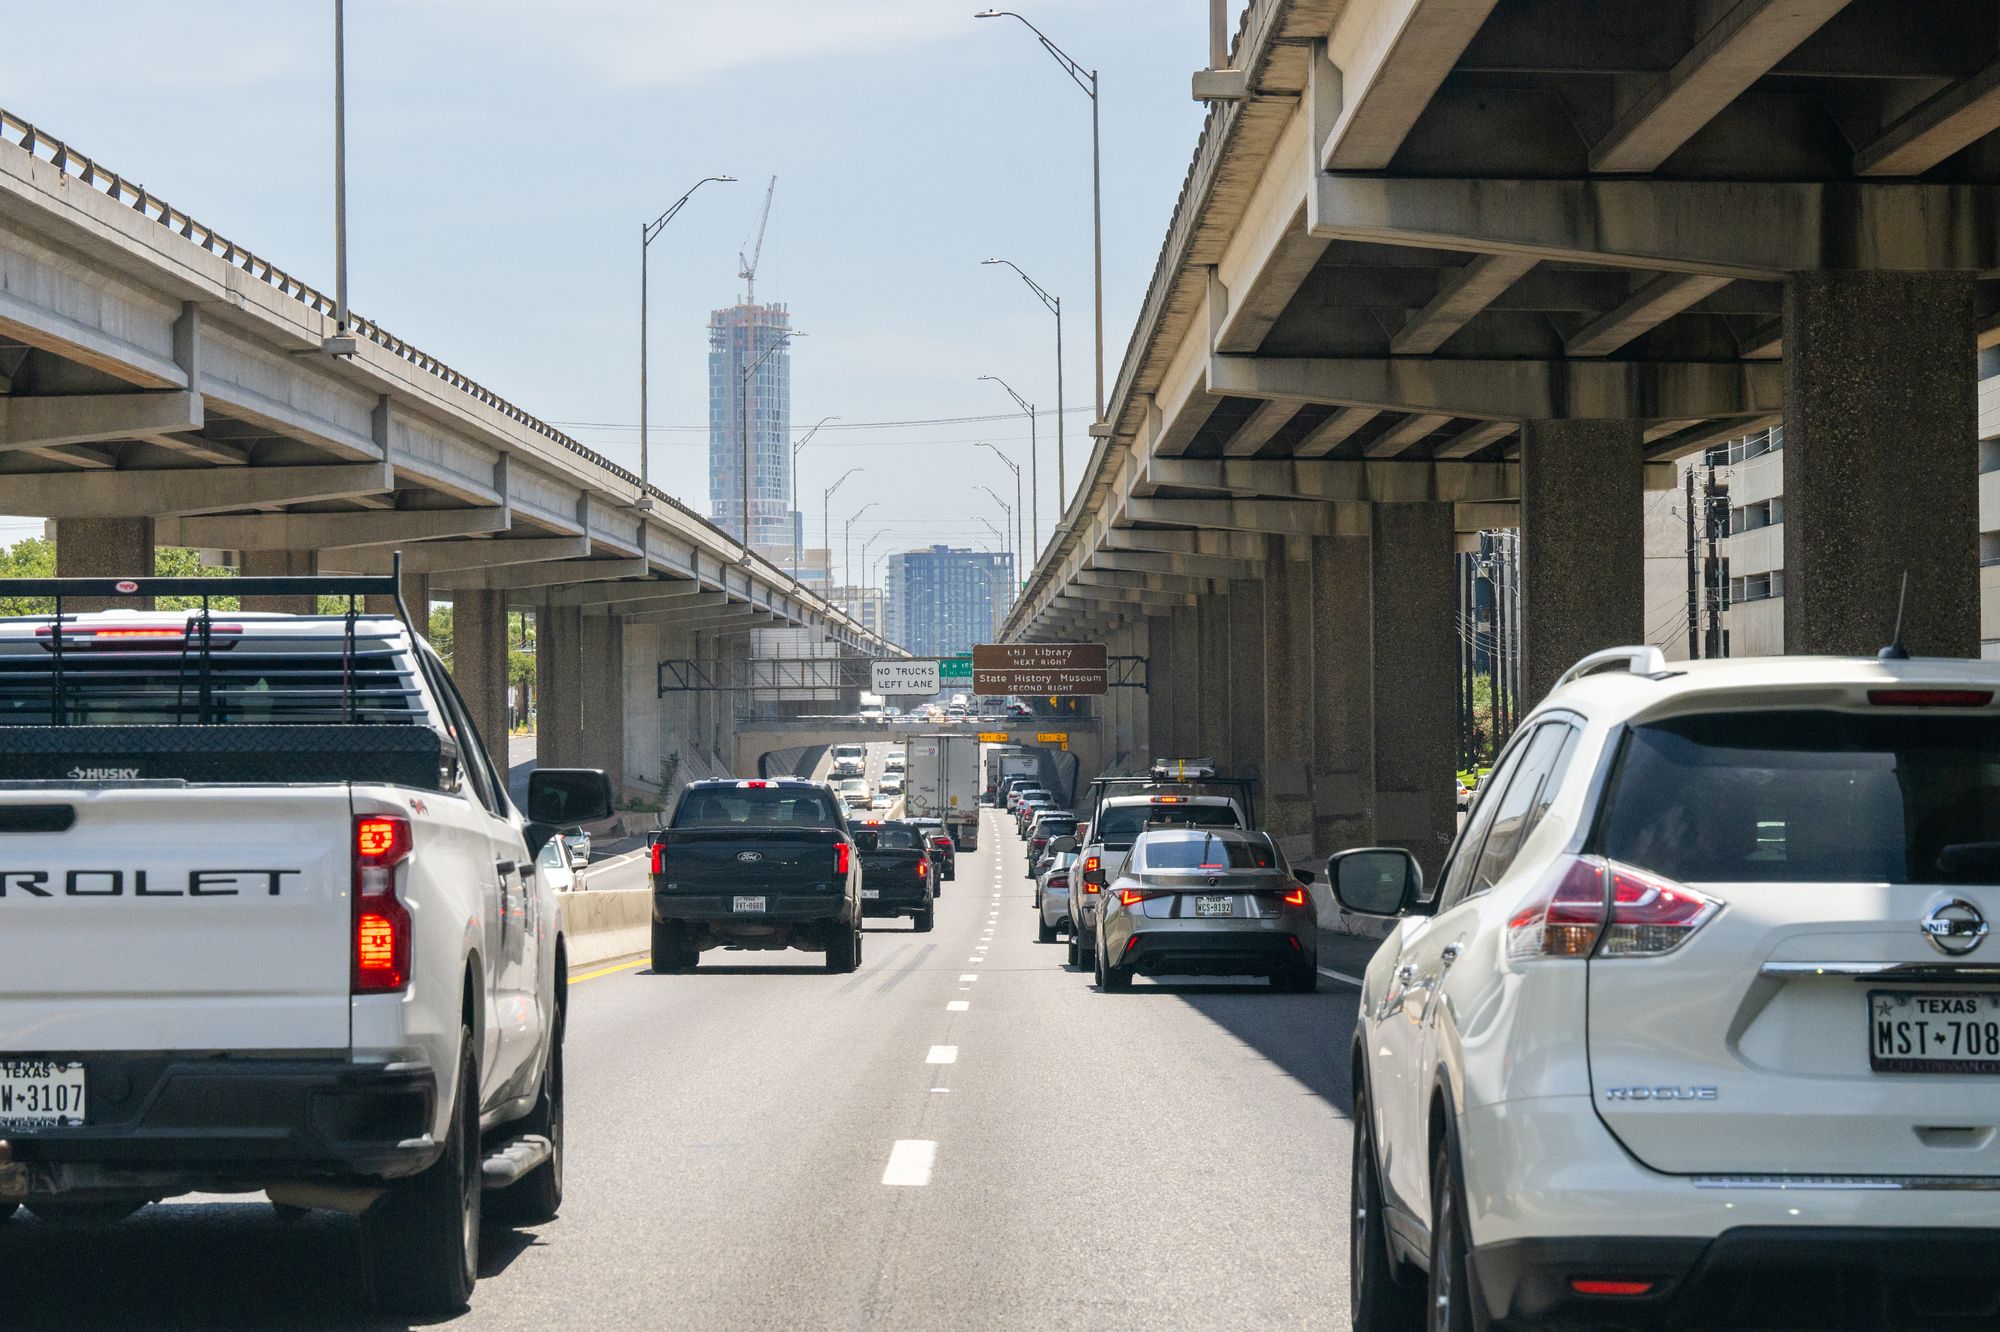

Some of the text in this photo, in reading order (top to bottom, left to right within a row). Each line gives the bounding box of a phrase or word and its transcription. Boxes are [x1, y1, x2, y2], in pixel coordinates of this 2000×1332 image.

[1035, 648, 1073, 658] Library
[876, 667, 935, 676] NO TRUCKS
[979, 674, 1102, 684] State History Museum
[878, 680, 933, 689] LEFT LANE
[86, 768, 140, 779] HUSKY
[1917, 999, 1977, 1014] TEXAS
[5, 1067, 51, 1078] TEXAS
[1606, 1086, 1717, 1101] ROGUE
